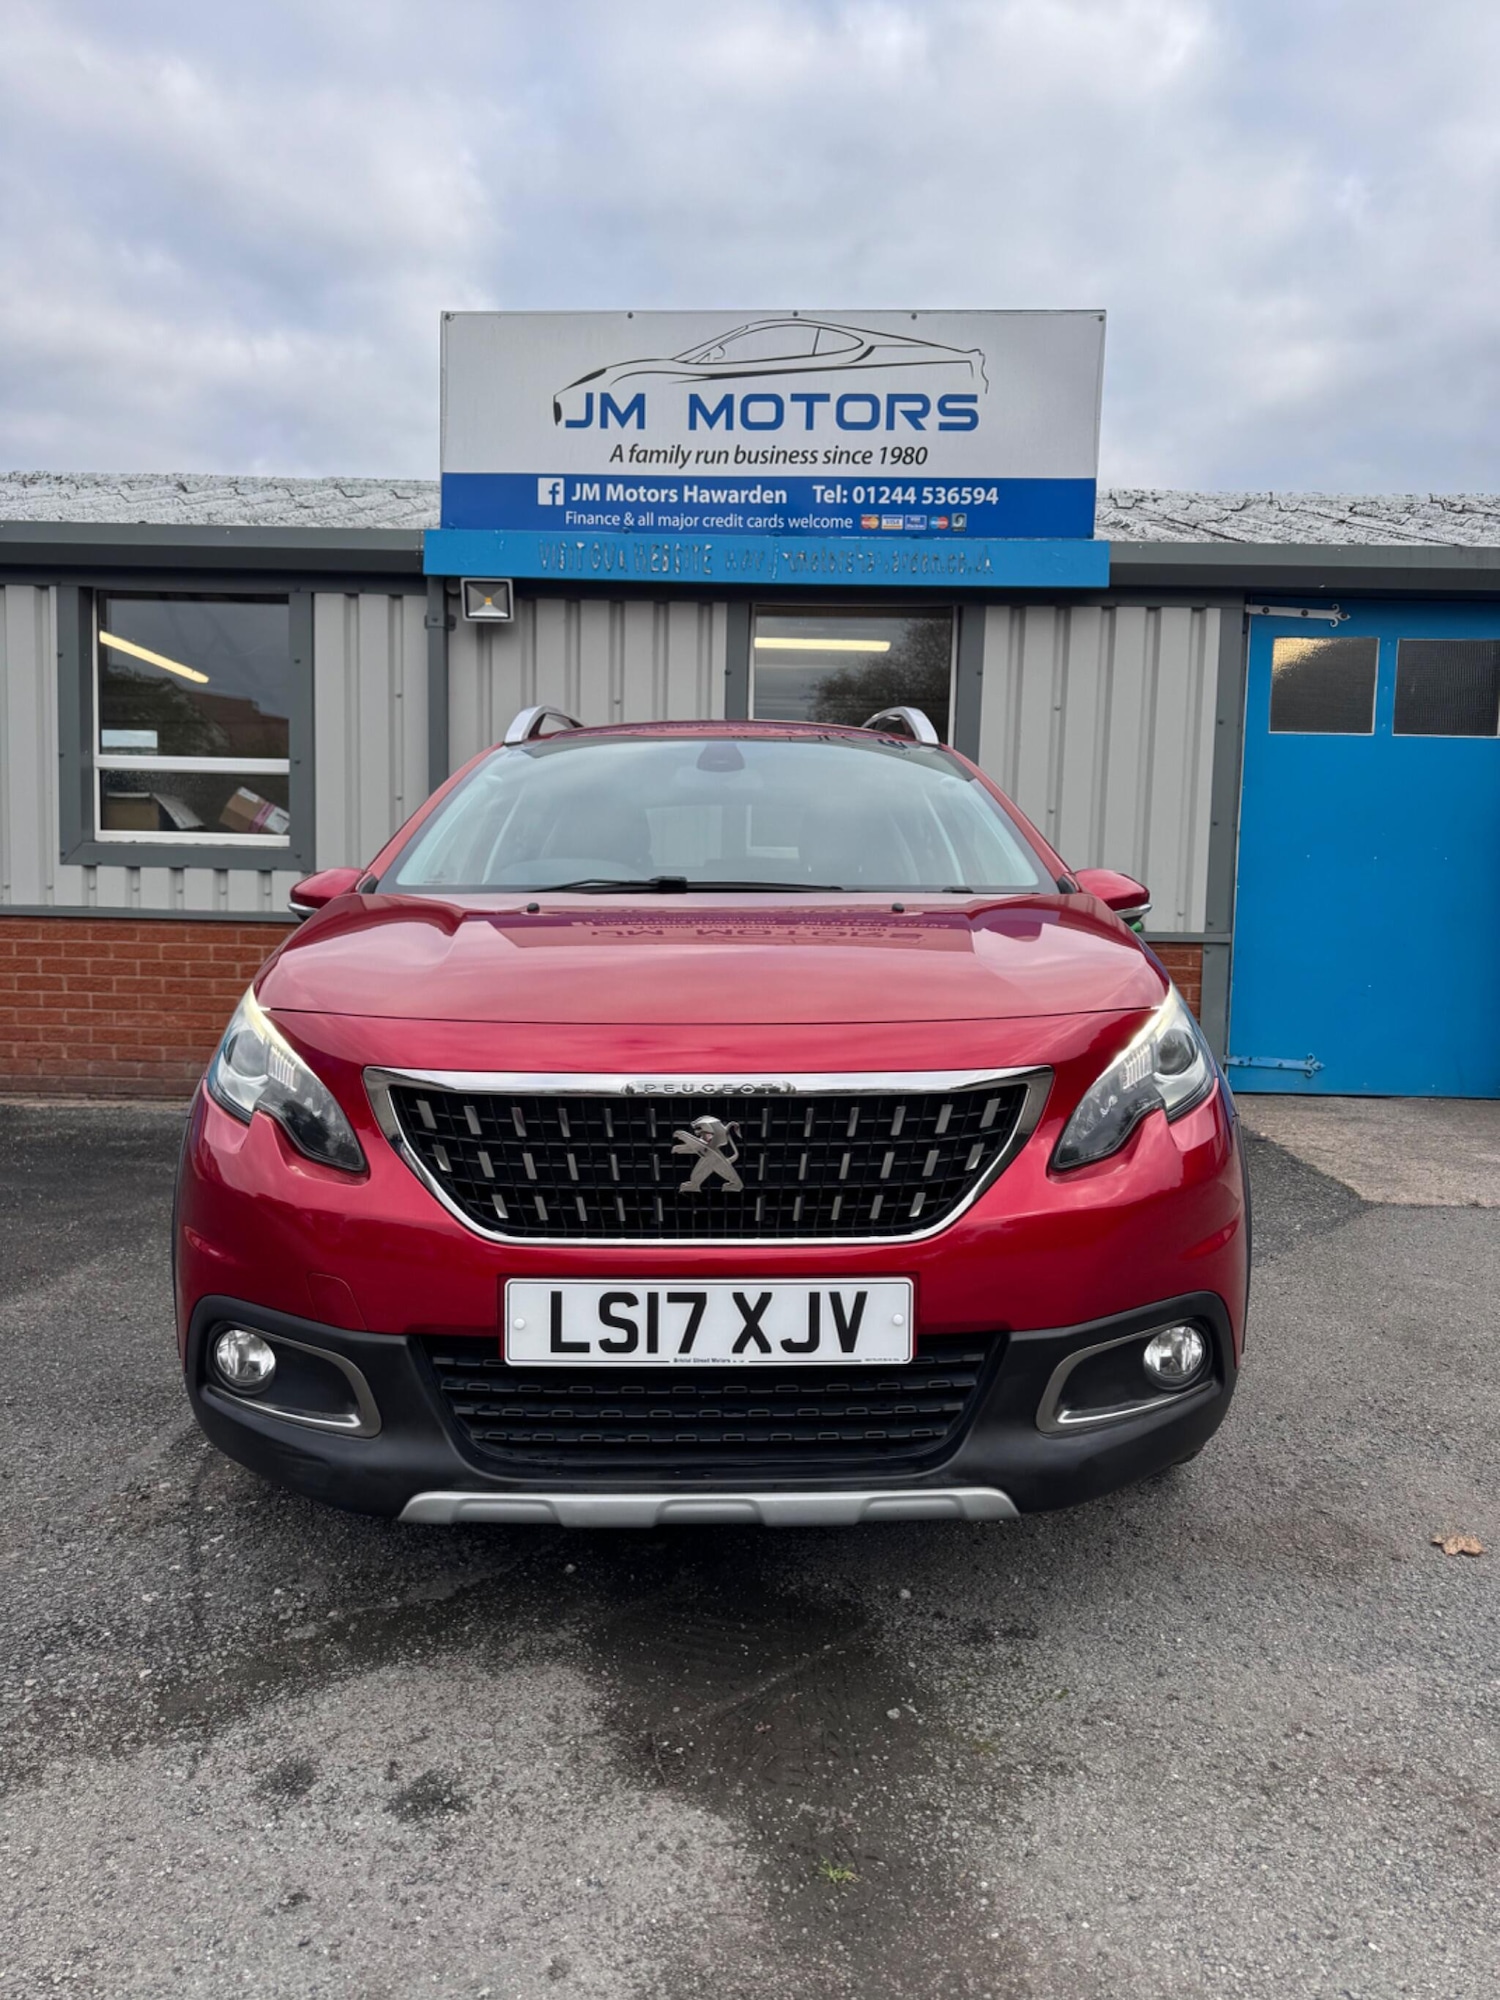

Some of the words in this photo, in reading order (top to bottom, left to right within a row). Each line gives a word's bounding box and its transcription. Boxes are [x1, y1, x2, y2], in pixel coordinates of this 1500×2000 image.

[565, 392, 646, 430] JM
[688, 392, 979, 431] MOTORS
[609, 444, 624, 463] A
[628, 443, 692, 470] family
[695, 449, 729, 465] run
[733, 444, 819, 465] business
[822, 445, 873, 465] since
[879, 446, 928, 465] 1980
[571, 483, 600, 501] JM
[606, 483, 678, 503] Motors
[683, 484, 787, 504] Hawarden
[812, 484, 848, 504] Tel:
[852, 486, 917, 505] 01244
[921, 486, 999, 505] 536594
[565, 511, 621, 526] Finance
[623, 511, 635, 526] &
[637, 512, 654, 526] all
[657, 513, 699, 530] major
[702, 513, 743, 528] credit
[746, 513, 784, 529] cards
[788, 514, 853, 529] welcome
[644, 1083, 774, 1094] PEUGEOT
[550, 1290, 708, 1354] LS17
[731, 1290, 869, 1354] XJV
